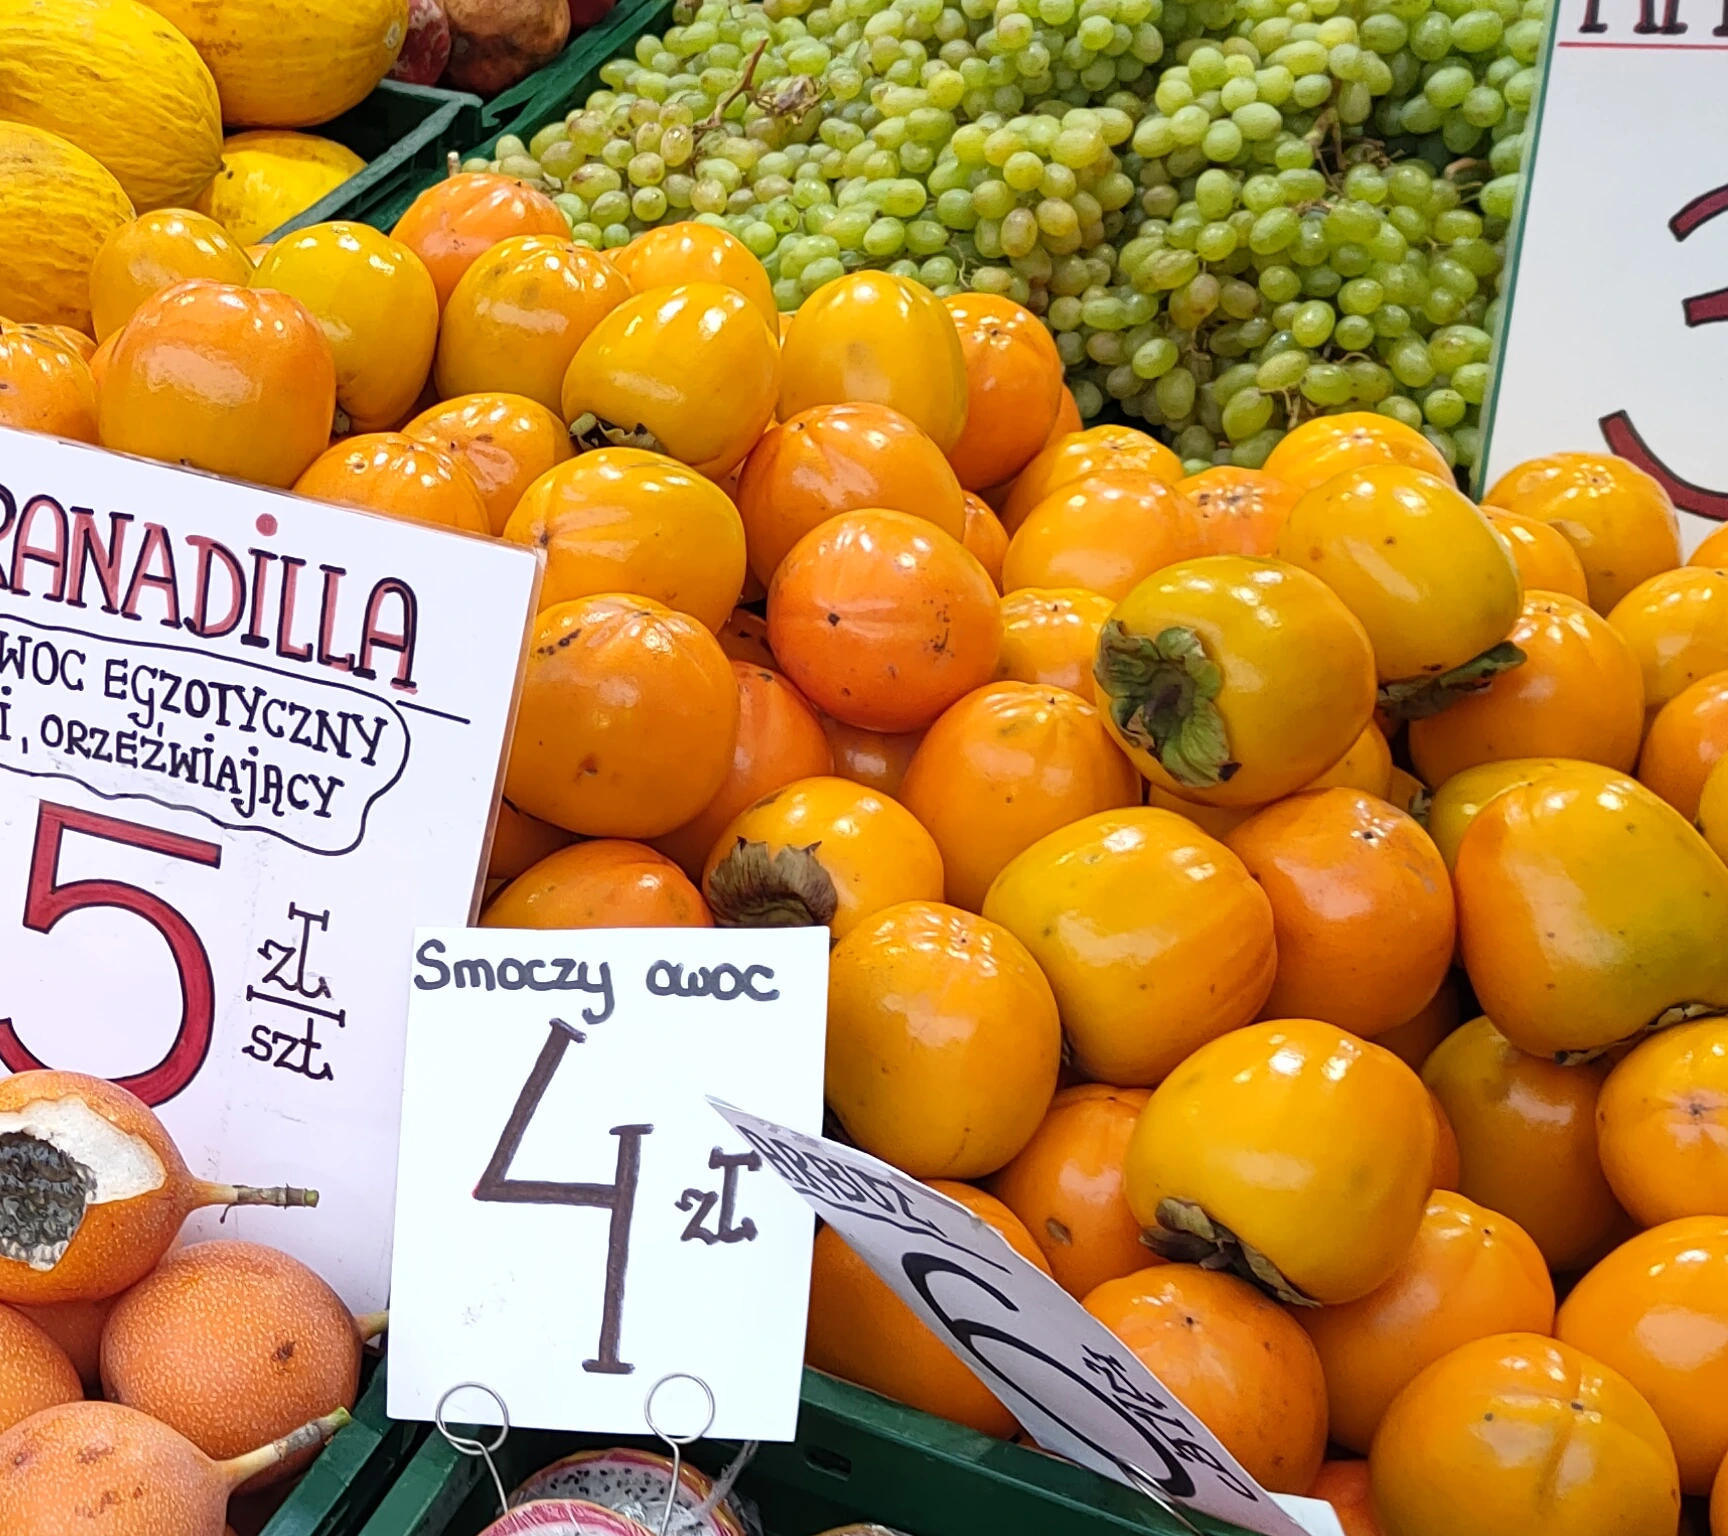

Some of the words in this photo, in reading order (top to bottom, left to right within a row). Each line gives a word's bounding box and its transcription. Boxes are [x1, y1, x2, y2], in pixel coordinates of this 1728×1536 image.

[103, 658, 388, 767] EGZOTYCZNY
[413, 938, 616, 1025] Smoczy
[646, 959, 780, 1002] owoc
[242, 1019, 334, 1081] szt
[472, 1018, 654, 1374] 4
[736, 1124, 948, 1238] ARBUZ
[901, 1251, 1197, 1499] 6
[1133, 1410, 1260, 1503] kg
